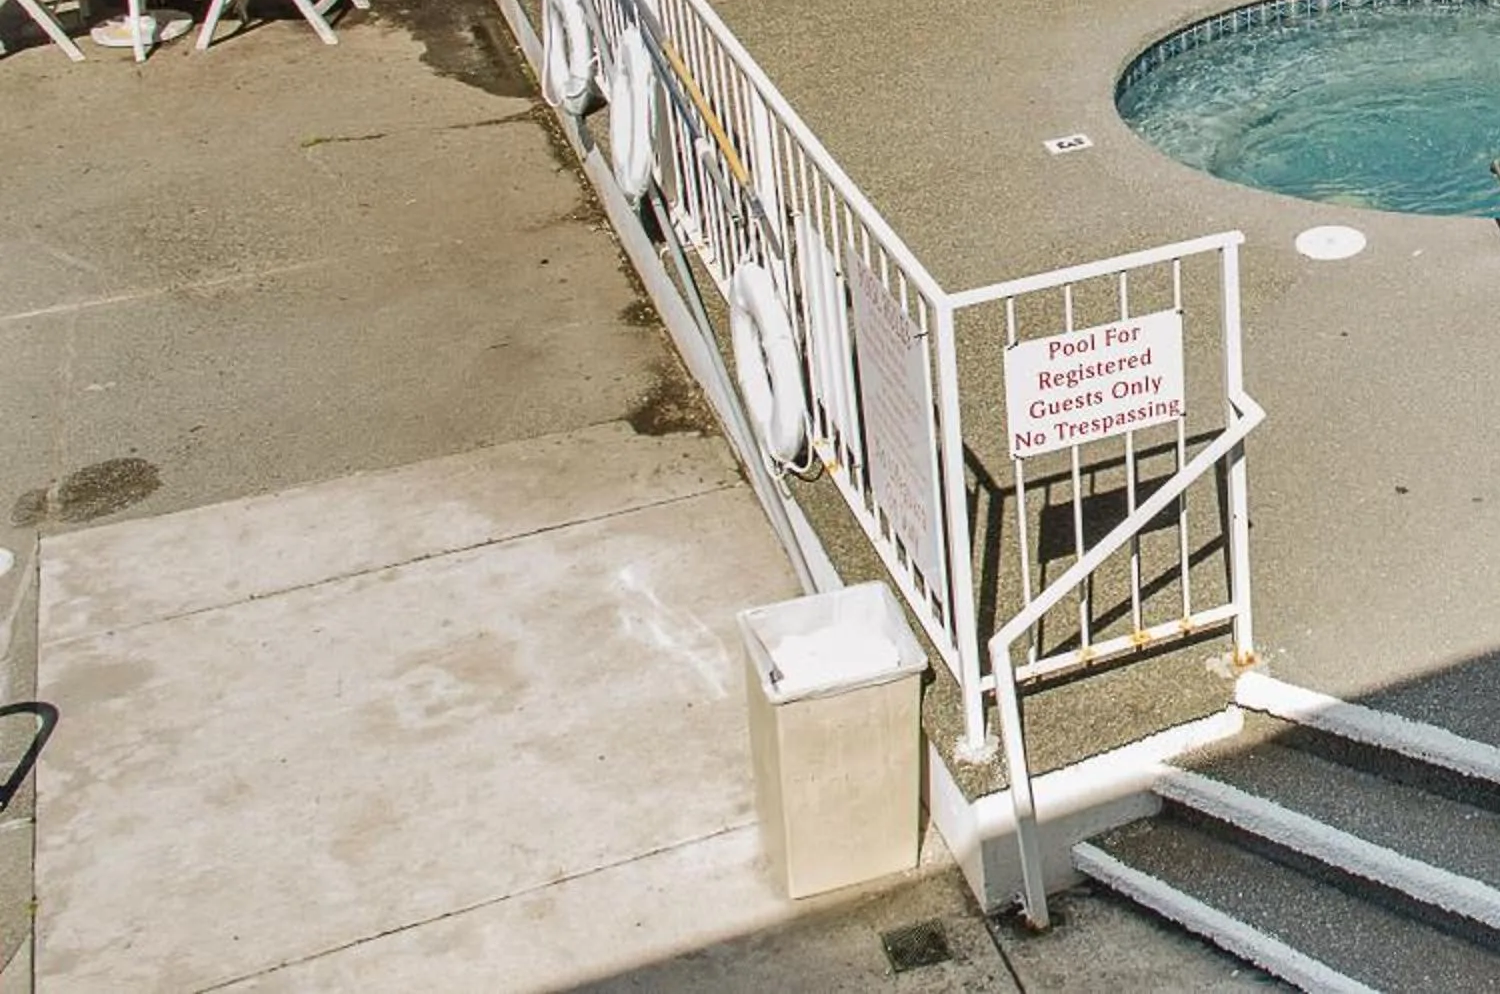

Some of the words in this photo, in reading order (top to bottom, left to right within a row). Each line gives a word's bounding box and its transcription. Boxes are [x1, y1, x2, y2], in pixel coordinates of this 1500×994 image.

[1048, 334, 1096, 361] Pool
[1105, 325, 1142, 347] For
[1037, 347, 1153, 392] Registered
[1029, 387, 1103, 420] Guests
[1111, 375, 1163, 401] Only
[1014, 431, 1047, 451] No
[1053, 399, 1182, 442] Trespassing
